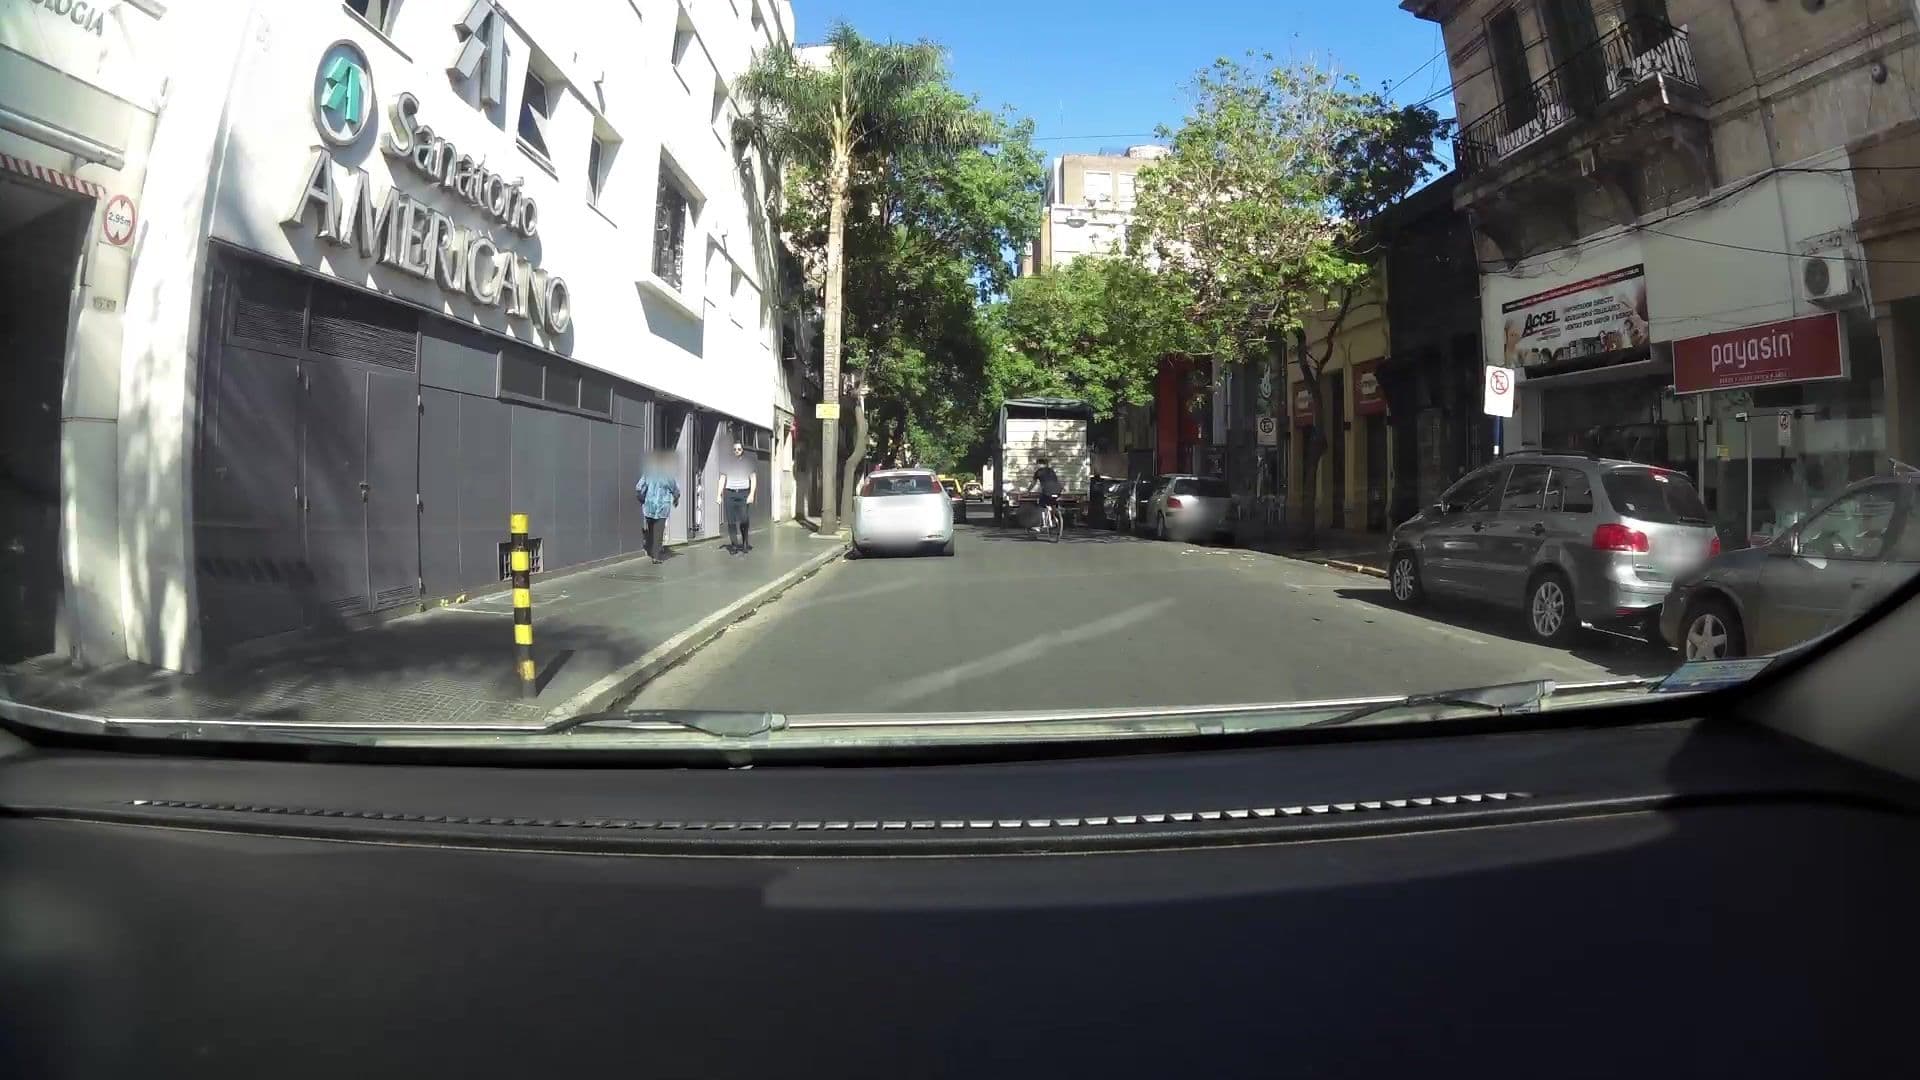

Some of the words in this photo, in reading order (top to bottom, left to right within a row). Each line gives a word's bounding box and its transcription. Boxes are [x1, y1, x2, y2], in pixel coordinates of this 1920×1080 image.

[31, 0, 104, 37] LOGIA
[380, 91, 538, 238] Sanatorio
[280, 145, 571, 334] AMERICANO
[1522, 310, 1560, 330] ACCEL
[1711, 329, 1792, 372] payasin
